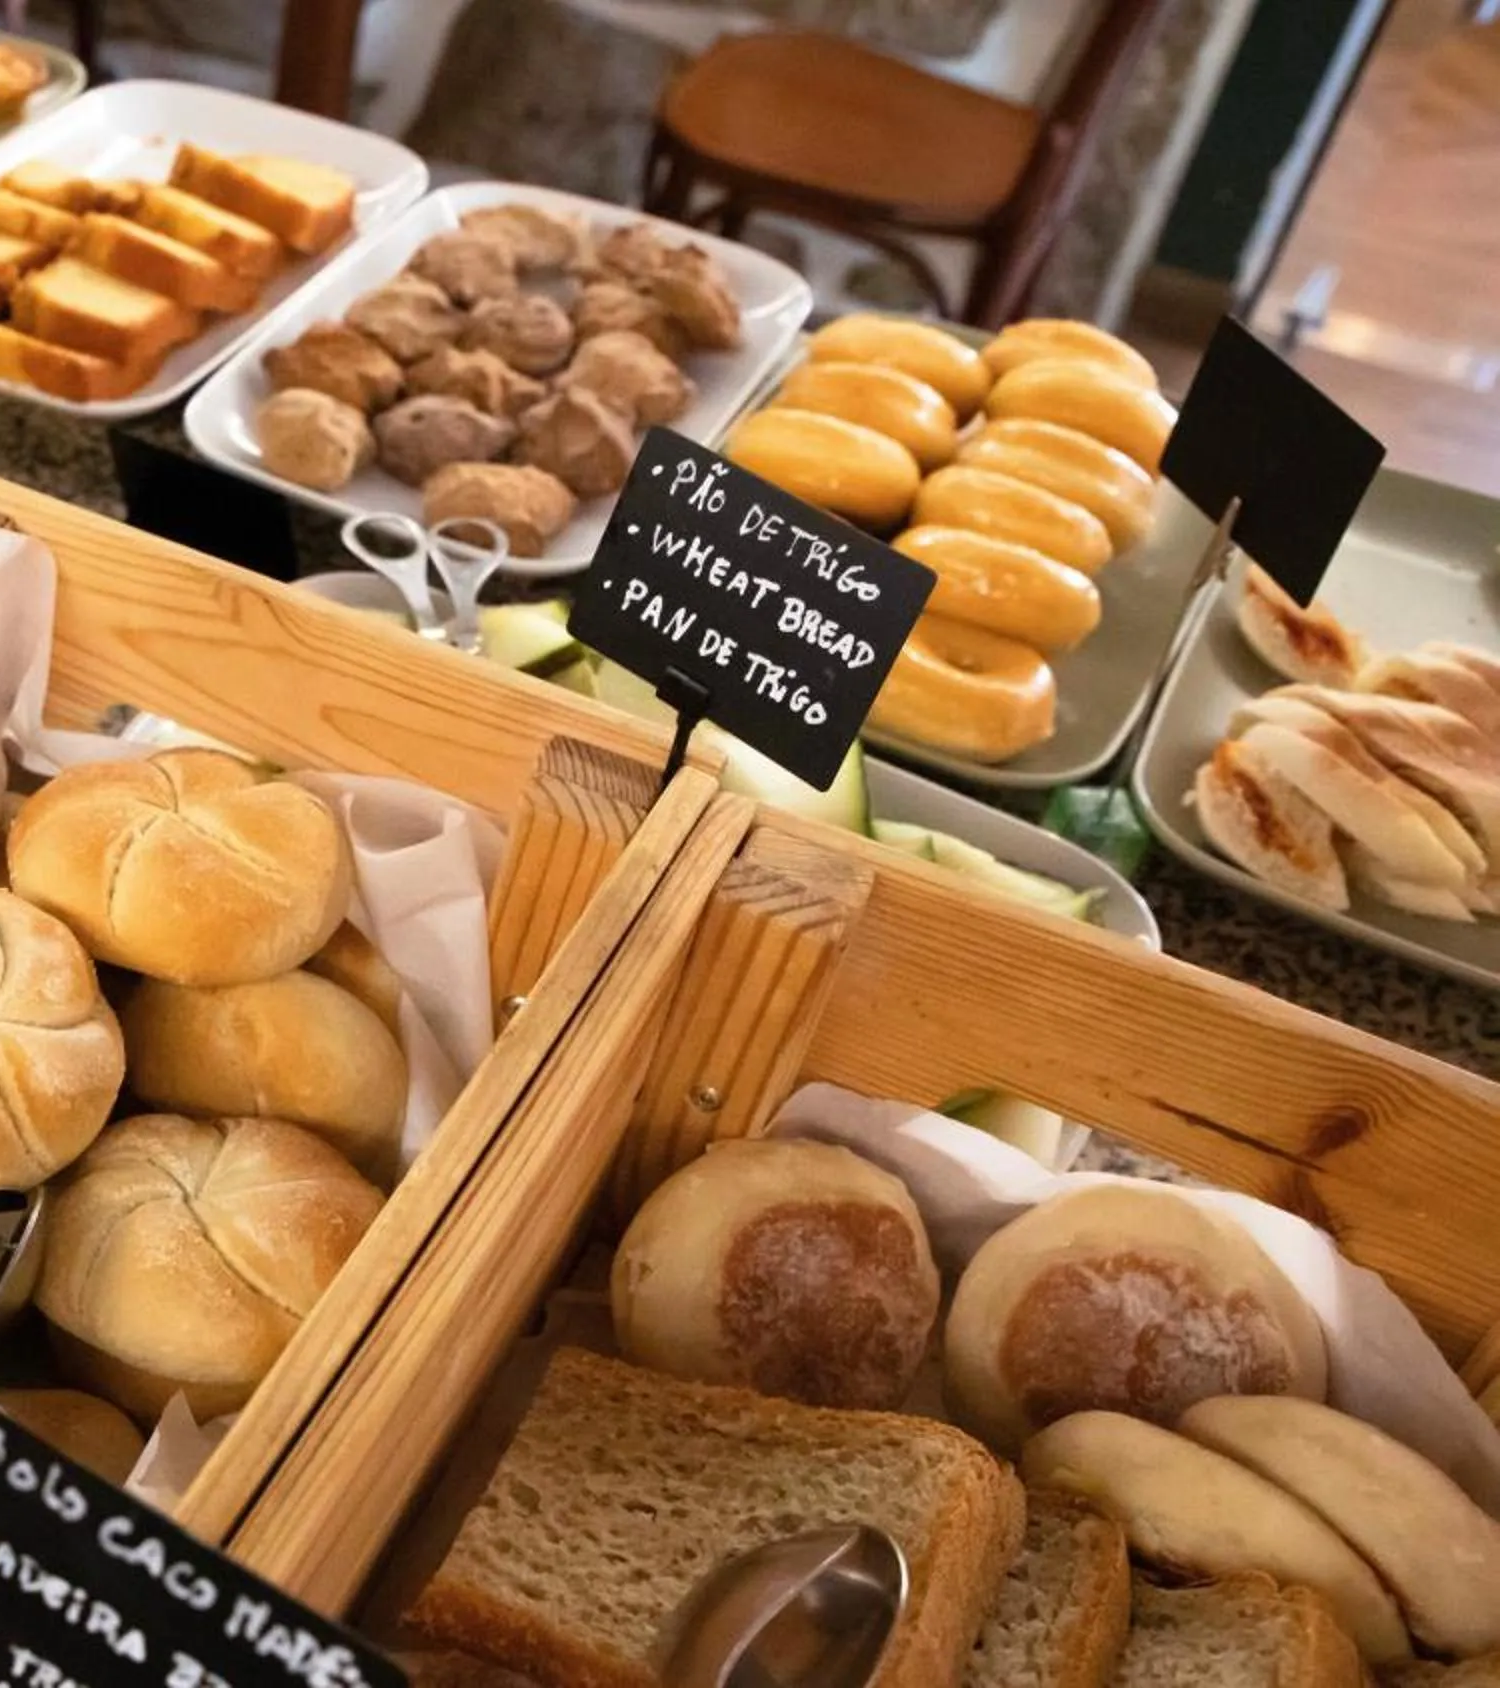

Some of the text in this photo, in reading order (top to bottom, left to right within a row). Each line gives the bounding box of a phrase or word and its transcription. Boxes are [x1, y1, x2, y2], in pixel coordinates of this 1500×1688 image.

[669, 456, 738, 513] PÃO
[738, 503, 785, 542] DE
[620, 578, 698, 642] PAN
[698, 628, 739, 667] DE
[652, 523, 876, 668] WHEAT BREAD
[100, 1517, 216, 1608] CACO
